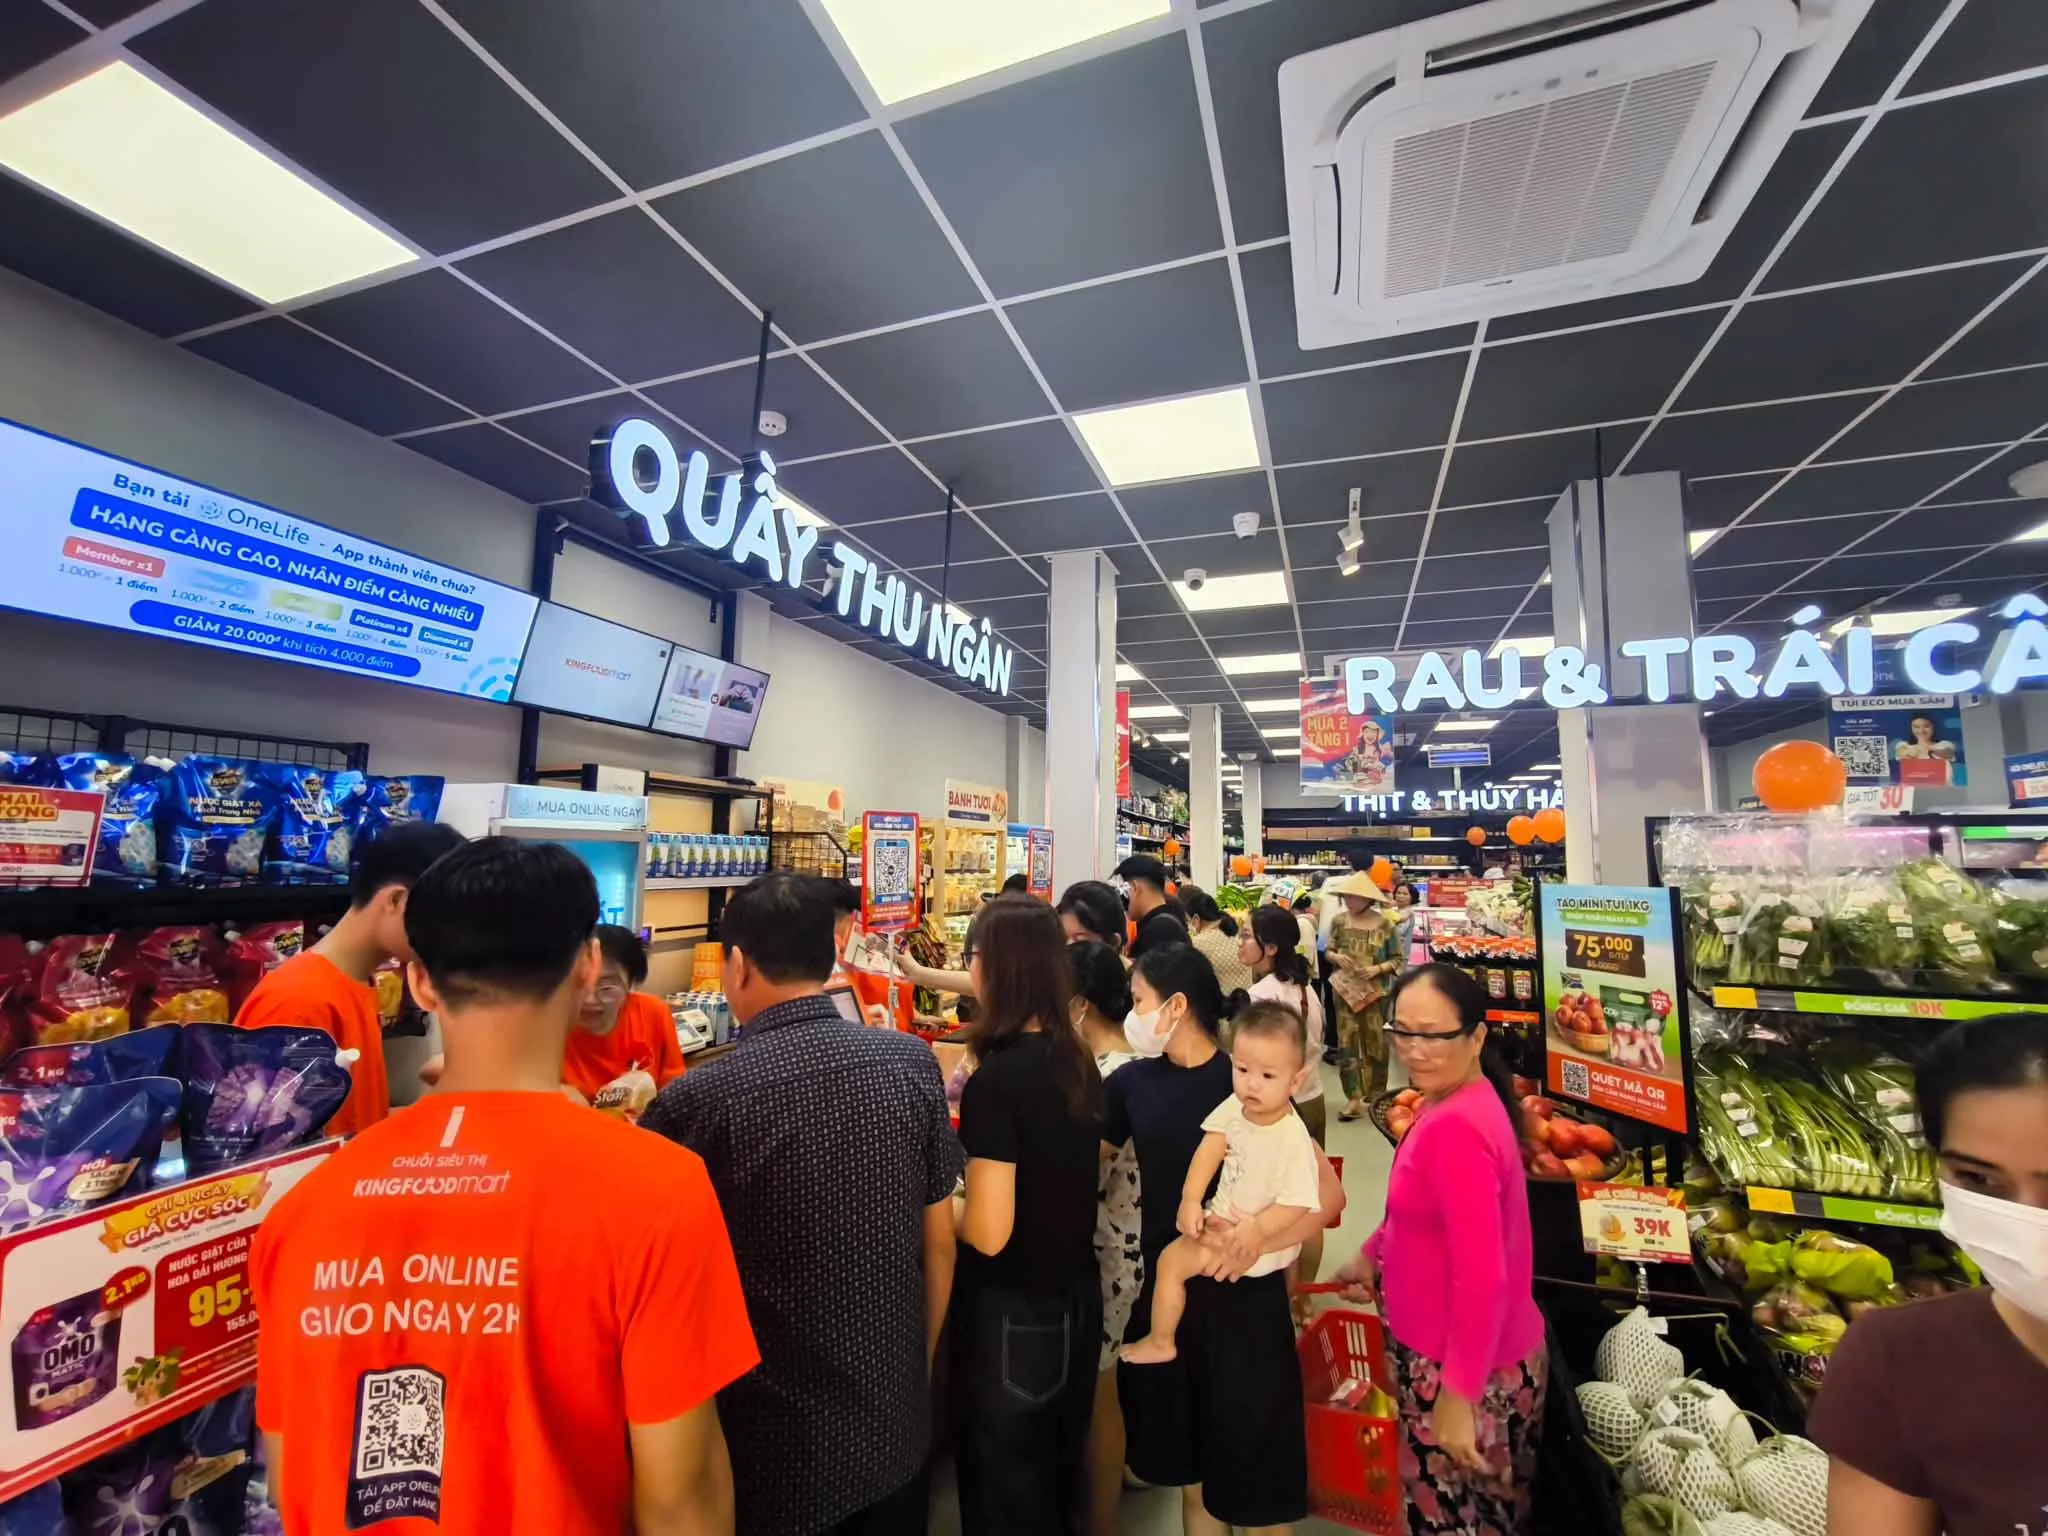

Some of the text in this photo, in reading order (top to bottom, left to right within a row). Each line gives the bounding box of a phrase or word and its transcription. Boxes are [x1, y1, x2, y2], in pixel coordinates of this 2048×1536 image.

[113, 473, 155, 497] Bạn
[227, 508, 310, 545] OneLife
[333, 543, 364, 562] App
[369, 554, 409, 576] thành
[412, 566, 438, 585] viên
[441, 578, 476, 596] chưa?
[75, 545, 154, 572] Member x1
[90, 504, 165, 537] HẠNG
[170, 528, 233, 557] CÀNG
[237, 547, 283, 574] CAO,
[287, 560, 342, 587] NHÂN
[388, 588, 431, 611] CÀNG
[609, 418, 1013, 697] QUẦY THU NGÂN
[115, 576, 123, 586] 1
[173, 614, 220, 635] GIẢM
[305, 639, 327, 657] tích
[1344, 646, 1522, 716] RAU
[1542, 645, 1608, 709] &
[1622, 604, 1874, 703] TRÁI
[1862, 697, 1885, 707] ECO
[1888, 696, 1915, 706] MUA
[1307, 716, 1348, 731] MUA 2
[537, 800, 642, 819] MUA ONLINE NGAY
[1340, 790, 1405, 819] THỊT
[1411, 790, 1433, 811] &
[1438, 781, 1520, 811] THỦY
[1579, 898, 1604, 910] MINI
[1628, 900, 1650, 911] 1KG
[1573, 933, 1634, 958] 75.000
[1646, 1086, 1665, 1101] QR
[392, 1152, 489, 1169] CHUỖI SIÊU THỊ
[353, 1170, 511, 1197] KINGFOODmart
[124, 1217, 162, 1247] GIÁ
[165, 1206, 206, 1230] CỰC
[211, 1194, 250, 1216] SỐC
[1633, 1217, 1672, 1238] 39K
[168, 1253, 199, 1273] NƯỚC
[201, 1244, 225, 1262] GIẶT
[226, 1236, 248, 1253] CỦA
[167, 1273, 190, 1290] HOA
[213, 1252, 249, 1273] HƯƠNG
[313, 1253, 519, 1291] MUA ONLINE
[383, 1297, 477, 1336] NGAY
[43, 1333, 96, 1372] OMO
[356, 1484, 377, 1501] TẢI
[380, 1481, 408, 1495] APP
